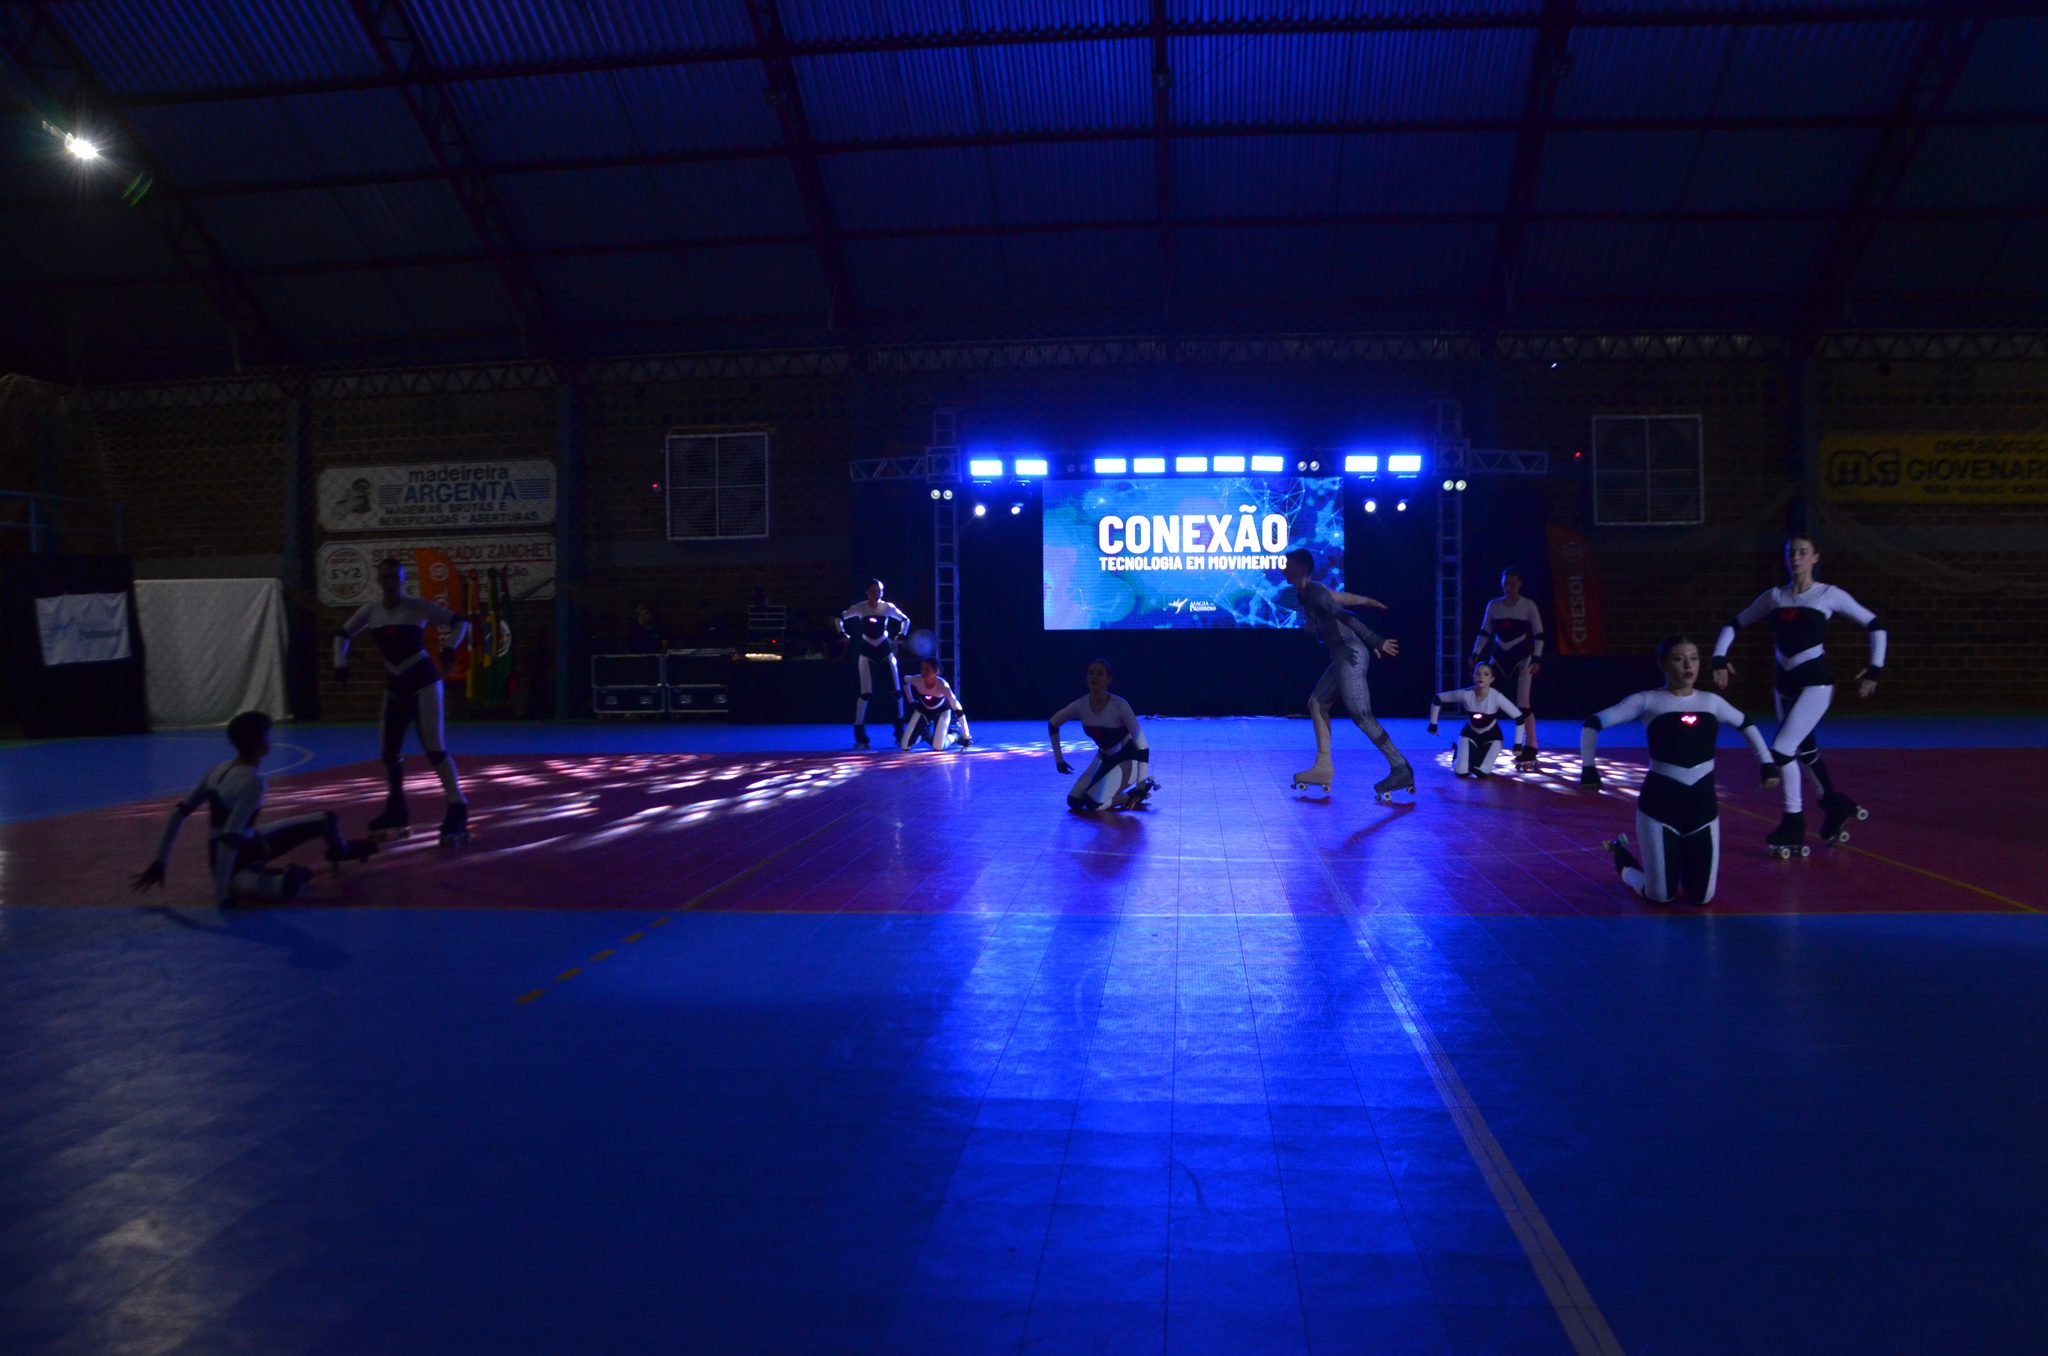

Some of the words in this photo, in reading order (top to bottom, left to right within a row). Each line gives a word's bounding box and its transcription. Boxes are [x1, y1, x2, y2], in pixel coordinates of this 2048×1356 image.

[409, 464, 509, 482] madeireira
[404, 481, 517, 503] ARGENTA
[385, 503, 442, 515] MADEIRAS
[449, 502, 494, 513] BRUTAS
[499, 501, 507, 511] E
[469, 511, 539, 523] ABERTURAS
[1099, 504, 1288, 554] CONEXÃO
[488, 543, 553, 558] ZANCHET
[1099, 556, 1183, 571] TECNOLOGIA
[1186, 556, 1205, 570] EM
[1208, 555, 1288, 570] MOVIMENTO
[1569, 575, 1587, 643] CRESOL
